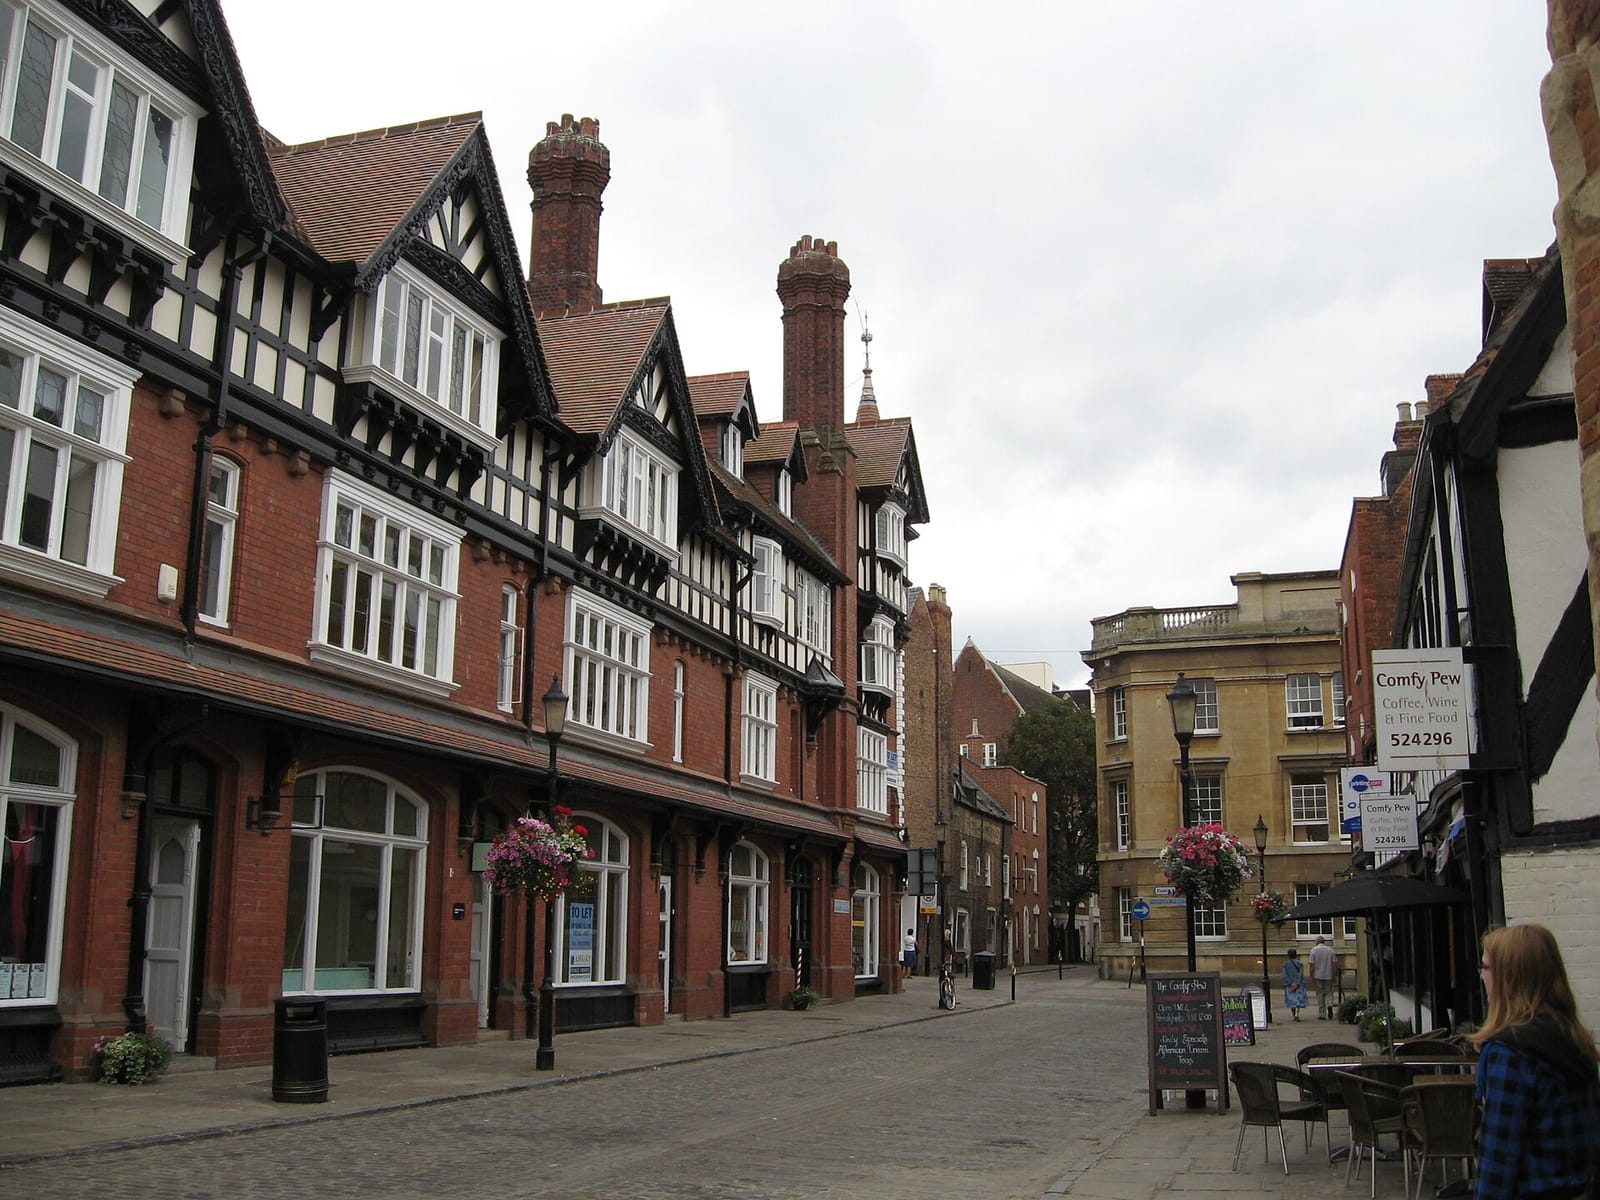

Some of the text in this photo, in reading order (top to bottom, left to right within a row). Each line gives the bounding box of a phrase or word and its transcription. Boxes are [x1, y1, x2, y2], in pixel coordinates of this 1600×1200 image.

[1376, 671, 1461, 689] Comfy Pew
[1382, 697, 1458, 709] Coffee, Wine
[1385, 712, 1458, 724] & Fine Food
[1391, 732, 1452, 746] 524296
[1366, 804, 1410, 813] Comfy Pew
[1375, 836, 1406, 844] 524296
[572, 906, 593, 919] TO LET
